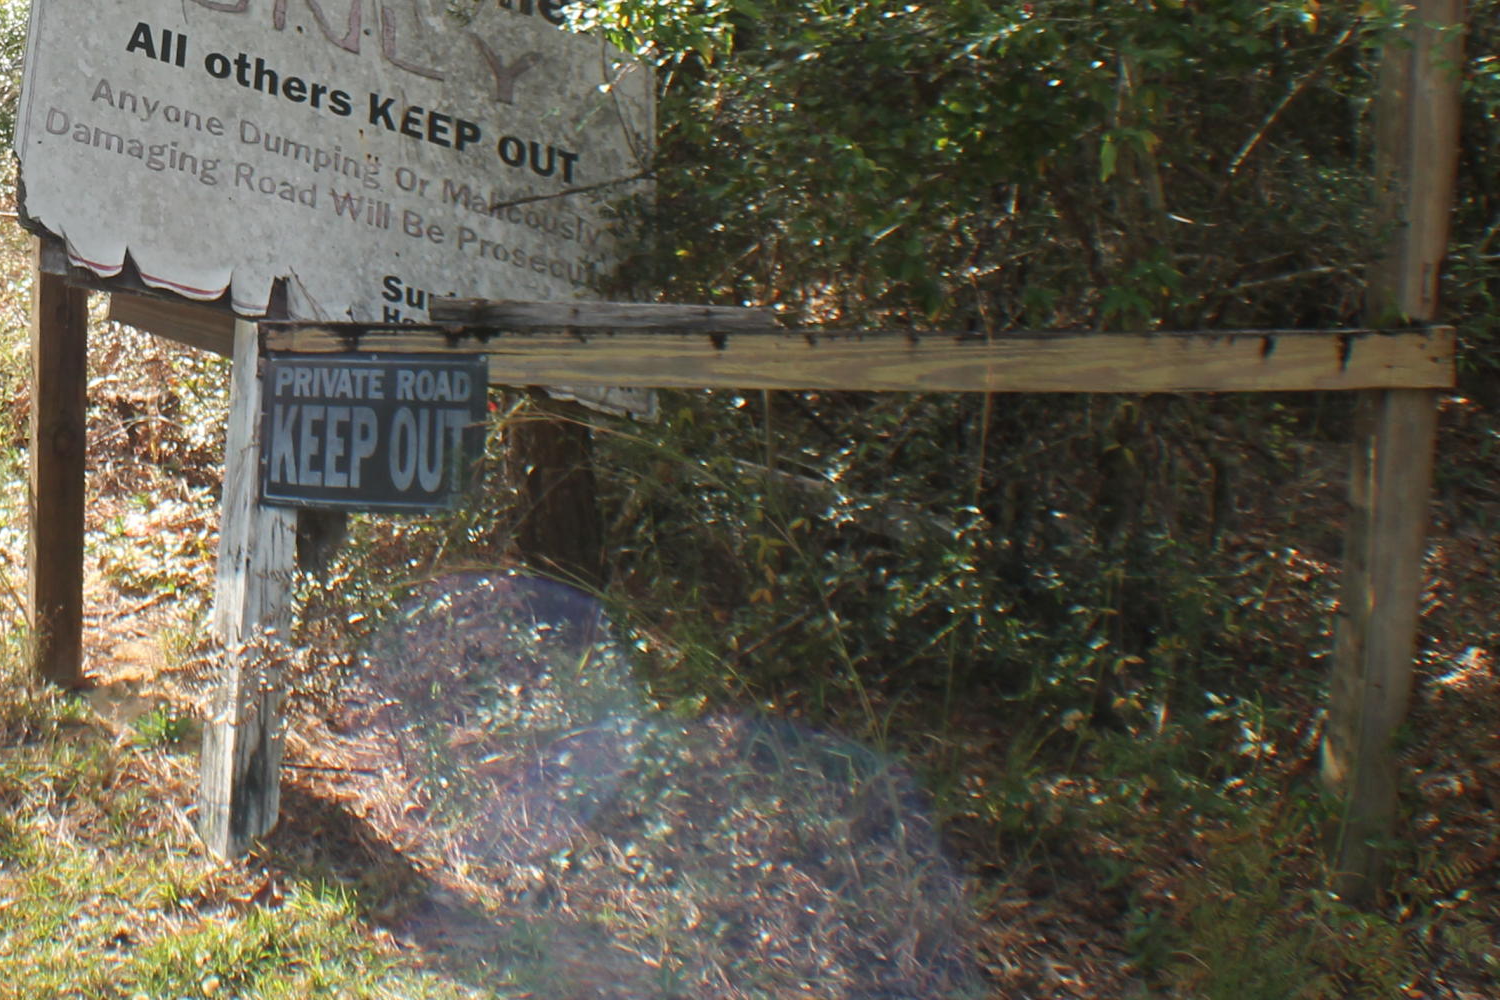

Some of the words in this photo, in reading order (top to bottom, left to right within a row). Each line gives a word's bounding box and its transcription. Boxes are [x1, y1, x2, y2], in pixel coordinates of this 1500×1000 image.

[91, 77, 225, 137] Anyone
[239, 118, 383, 191] Dumping
[394, 167, 430, 198] Or
[126, 21, 188, 68] All
[204, 53, 353, 118] others
[369, 93, 482, 152] KEEP
[498, 135, 580, 184] OUT
[45, 106, 221, 186] Damaging
[235, 162, 317, 209] Road
[328, 187, 390, 230] Will
[403, 209, 445, 245] Be
[275, 366, 386, 400] PRIVATE
[396, 368, 472, 402] ROAD
[270, 403, 379, 489] KEEP
[389, 405, 472, 493] OUT
